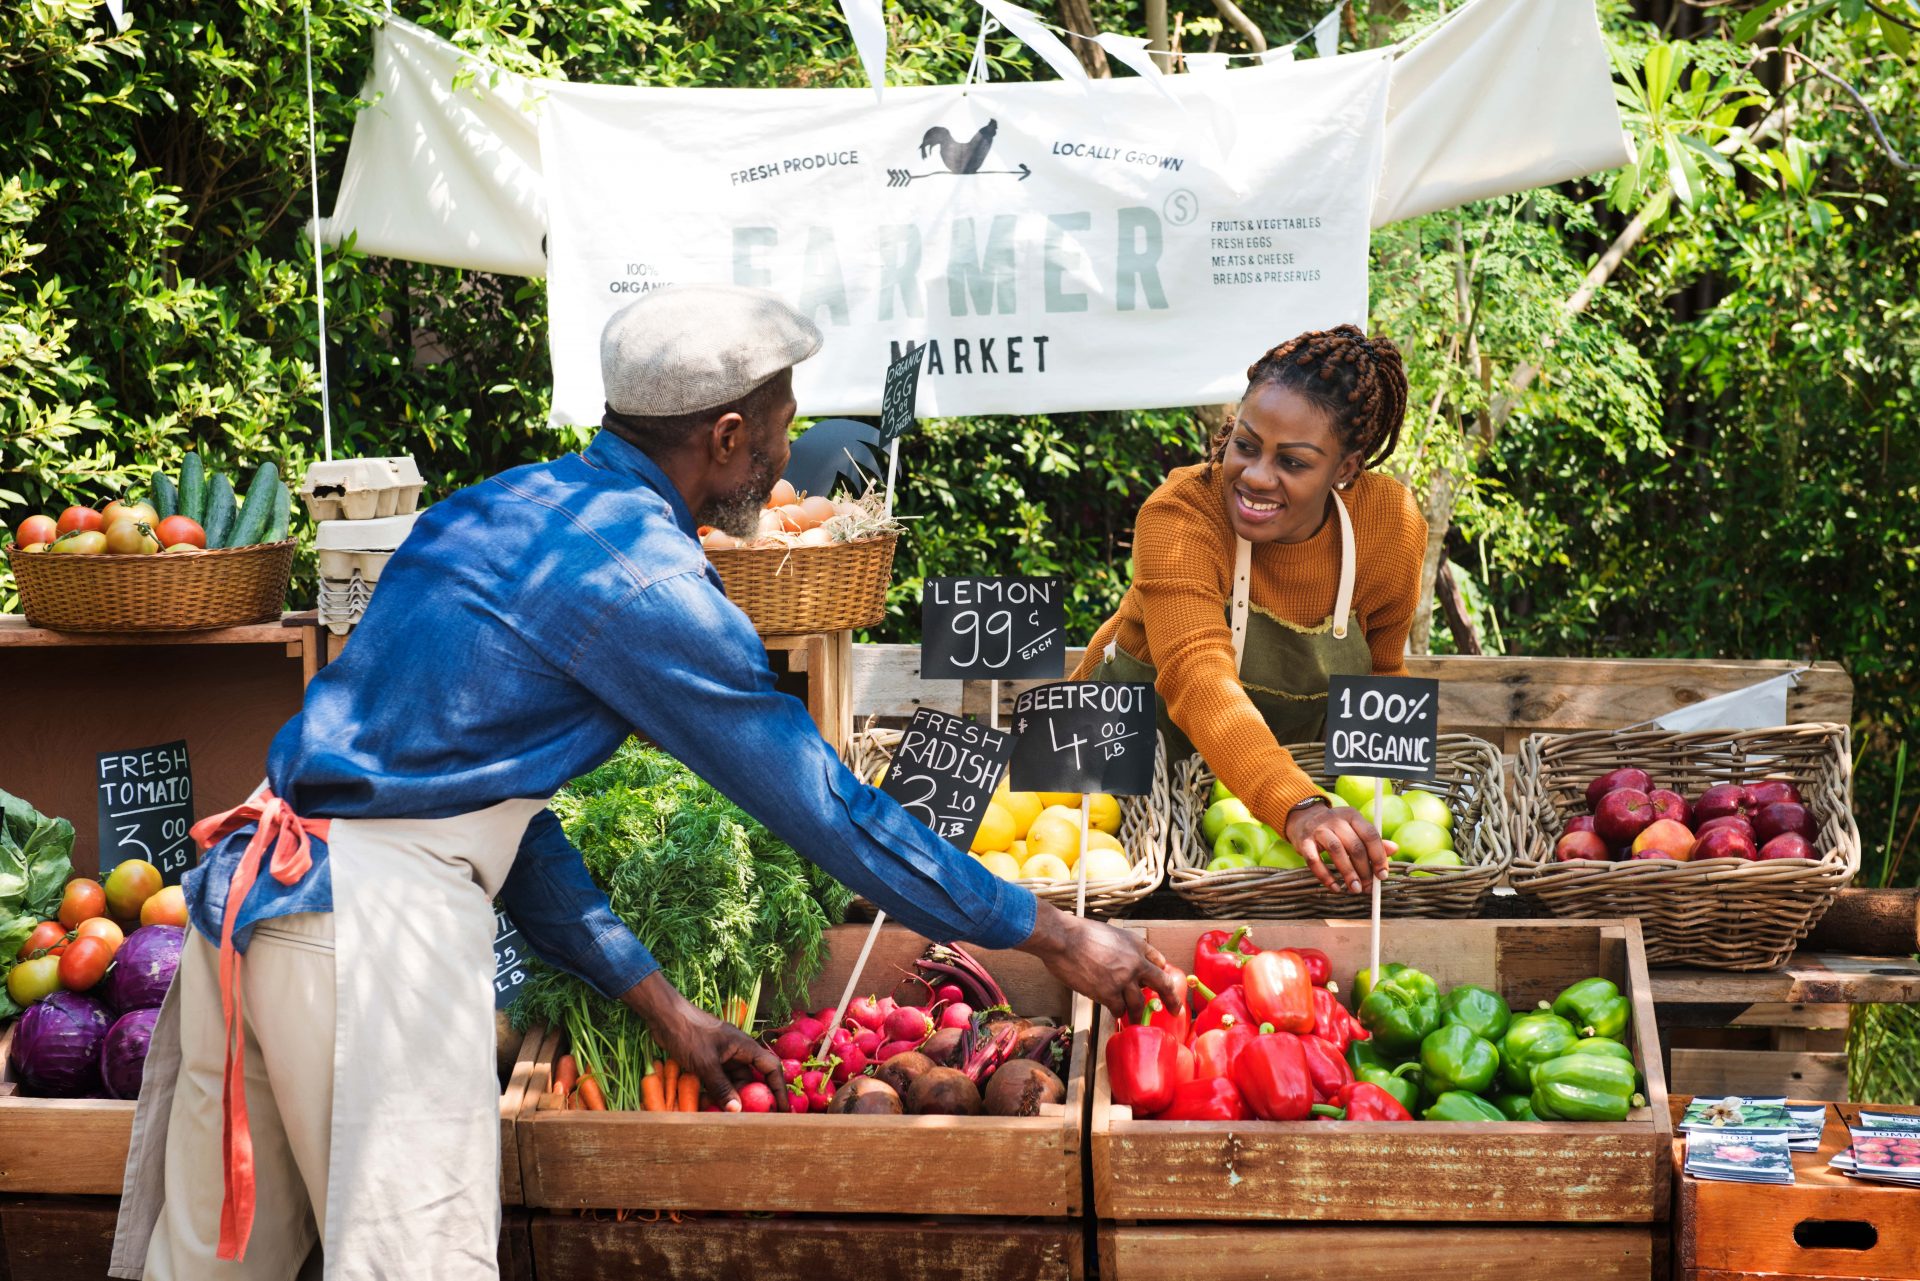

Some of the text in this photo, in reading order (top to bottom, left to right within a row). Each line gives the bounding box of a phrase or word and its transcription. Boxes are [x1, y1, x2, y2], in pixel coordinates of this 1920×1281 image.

[730, 150, 859, 187] FRESH PRODUCE
[1052, 141, 1184, 172] LOCALLY GROWN
[1211, 217, 1321, 232] FRUITS & VEGETABLES
[1211, 236, 1272, 249] FRESH EGGS
[626, 263, 659, 276] 100%
[732, 206, 1170, 327] FARMER
[1211, 253, 1295, 267] MEATS & CHEESE
[1213, 269, 1321, 285] BREADS & PRESERVES
[887, 349, 923, 384] ORGANIC
[883, 373, 913, 411] EGG
[950, 610, 1012, 668] 99
[1022, 637, 1053, 660] EACH
[1016, 685, 1146, 713] BEETROOT
[1340, 687, 1430, 725] 100%
[913, 711, 1004, 752] FRESH
[1104, 742, 1125, 761] LB
[1332, 730, 1431, 763] ORGANIC
[100, 747, 188, 779] FRESH
[899, 730, 1002, 794] RADISH
[100, 776, 190, 806] TOMATO
[946, 790, 976, 812] 10
[162, 818, 186, 840] 00
[938, 821, 965, 838] LB
[163, 849, 187, 873] LB
[496, 970, 526, 993] LB
